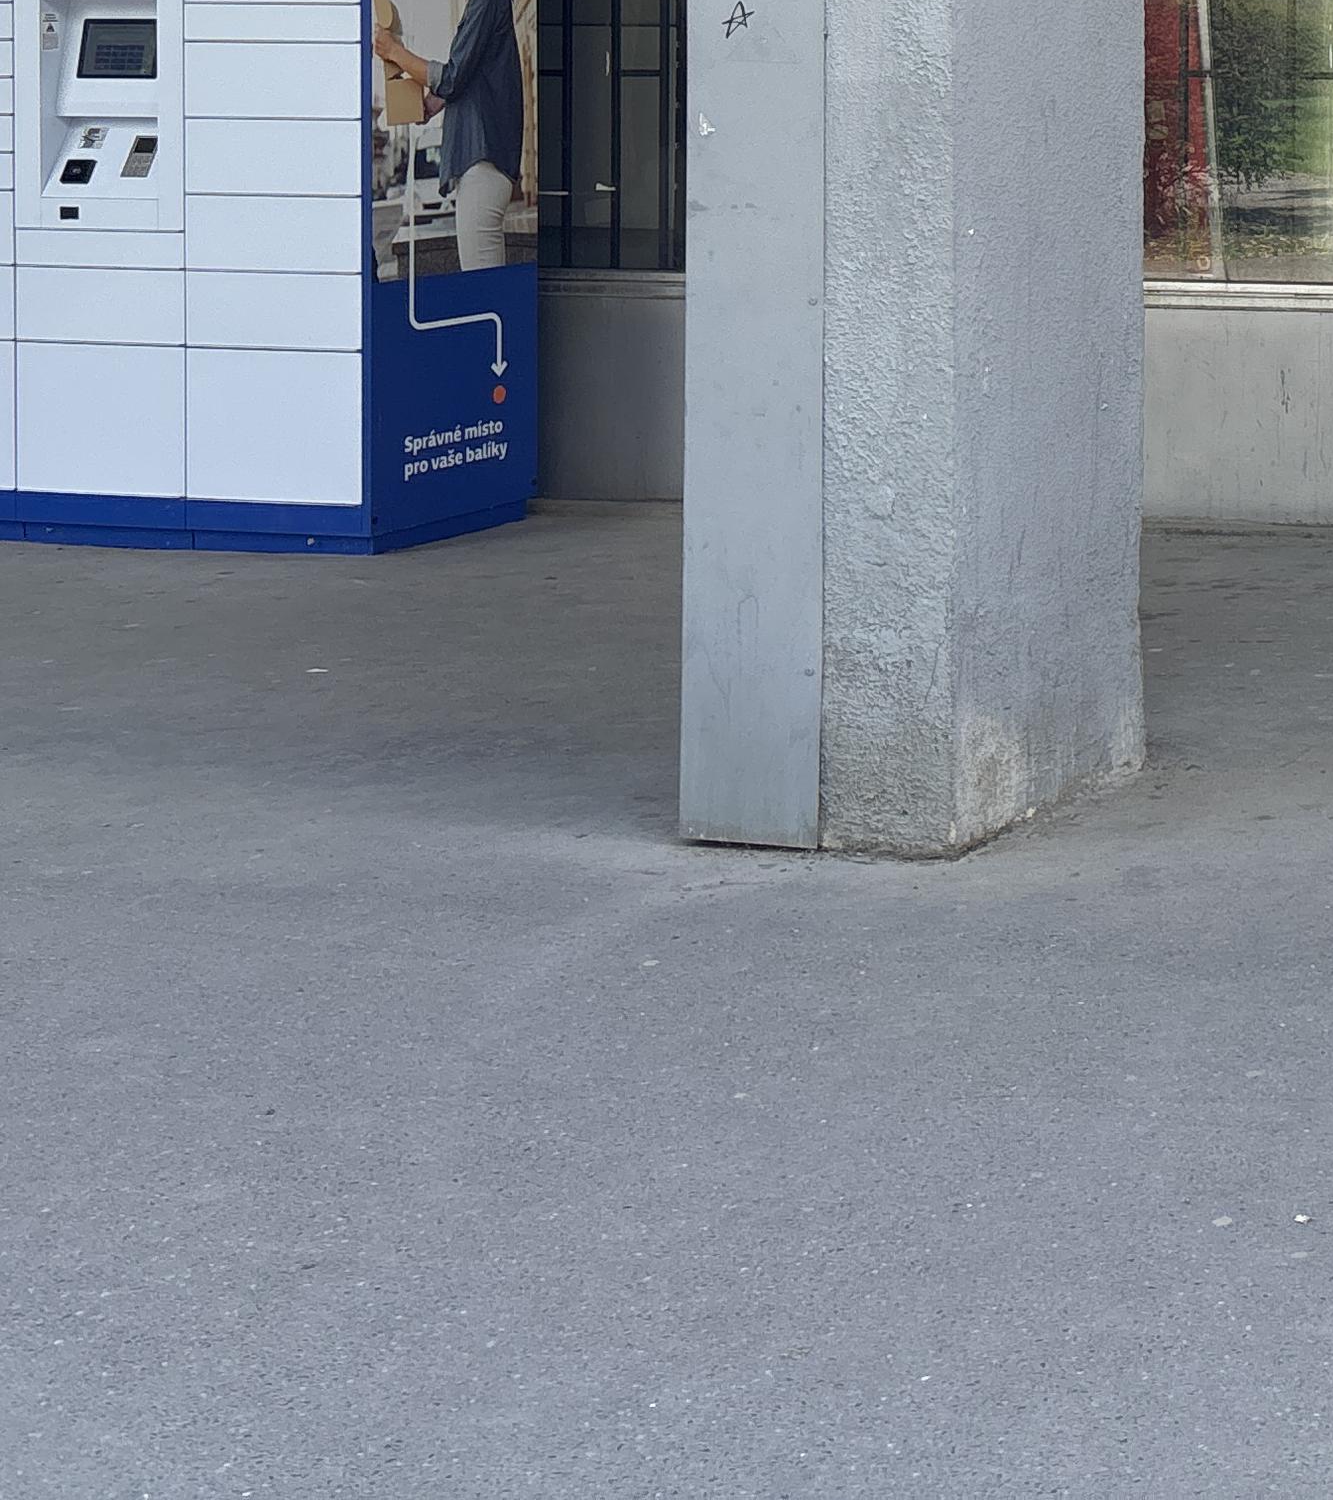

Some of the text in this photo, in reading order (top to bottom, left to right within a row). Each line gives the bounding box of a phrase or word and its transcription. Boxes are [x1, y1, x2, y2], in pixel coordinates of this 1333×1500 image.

[404, 419, 504, 454] Správné místo
[404, 439, 508, 481] pro vaše balíky
